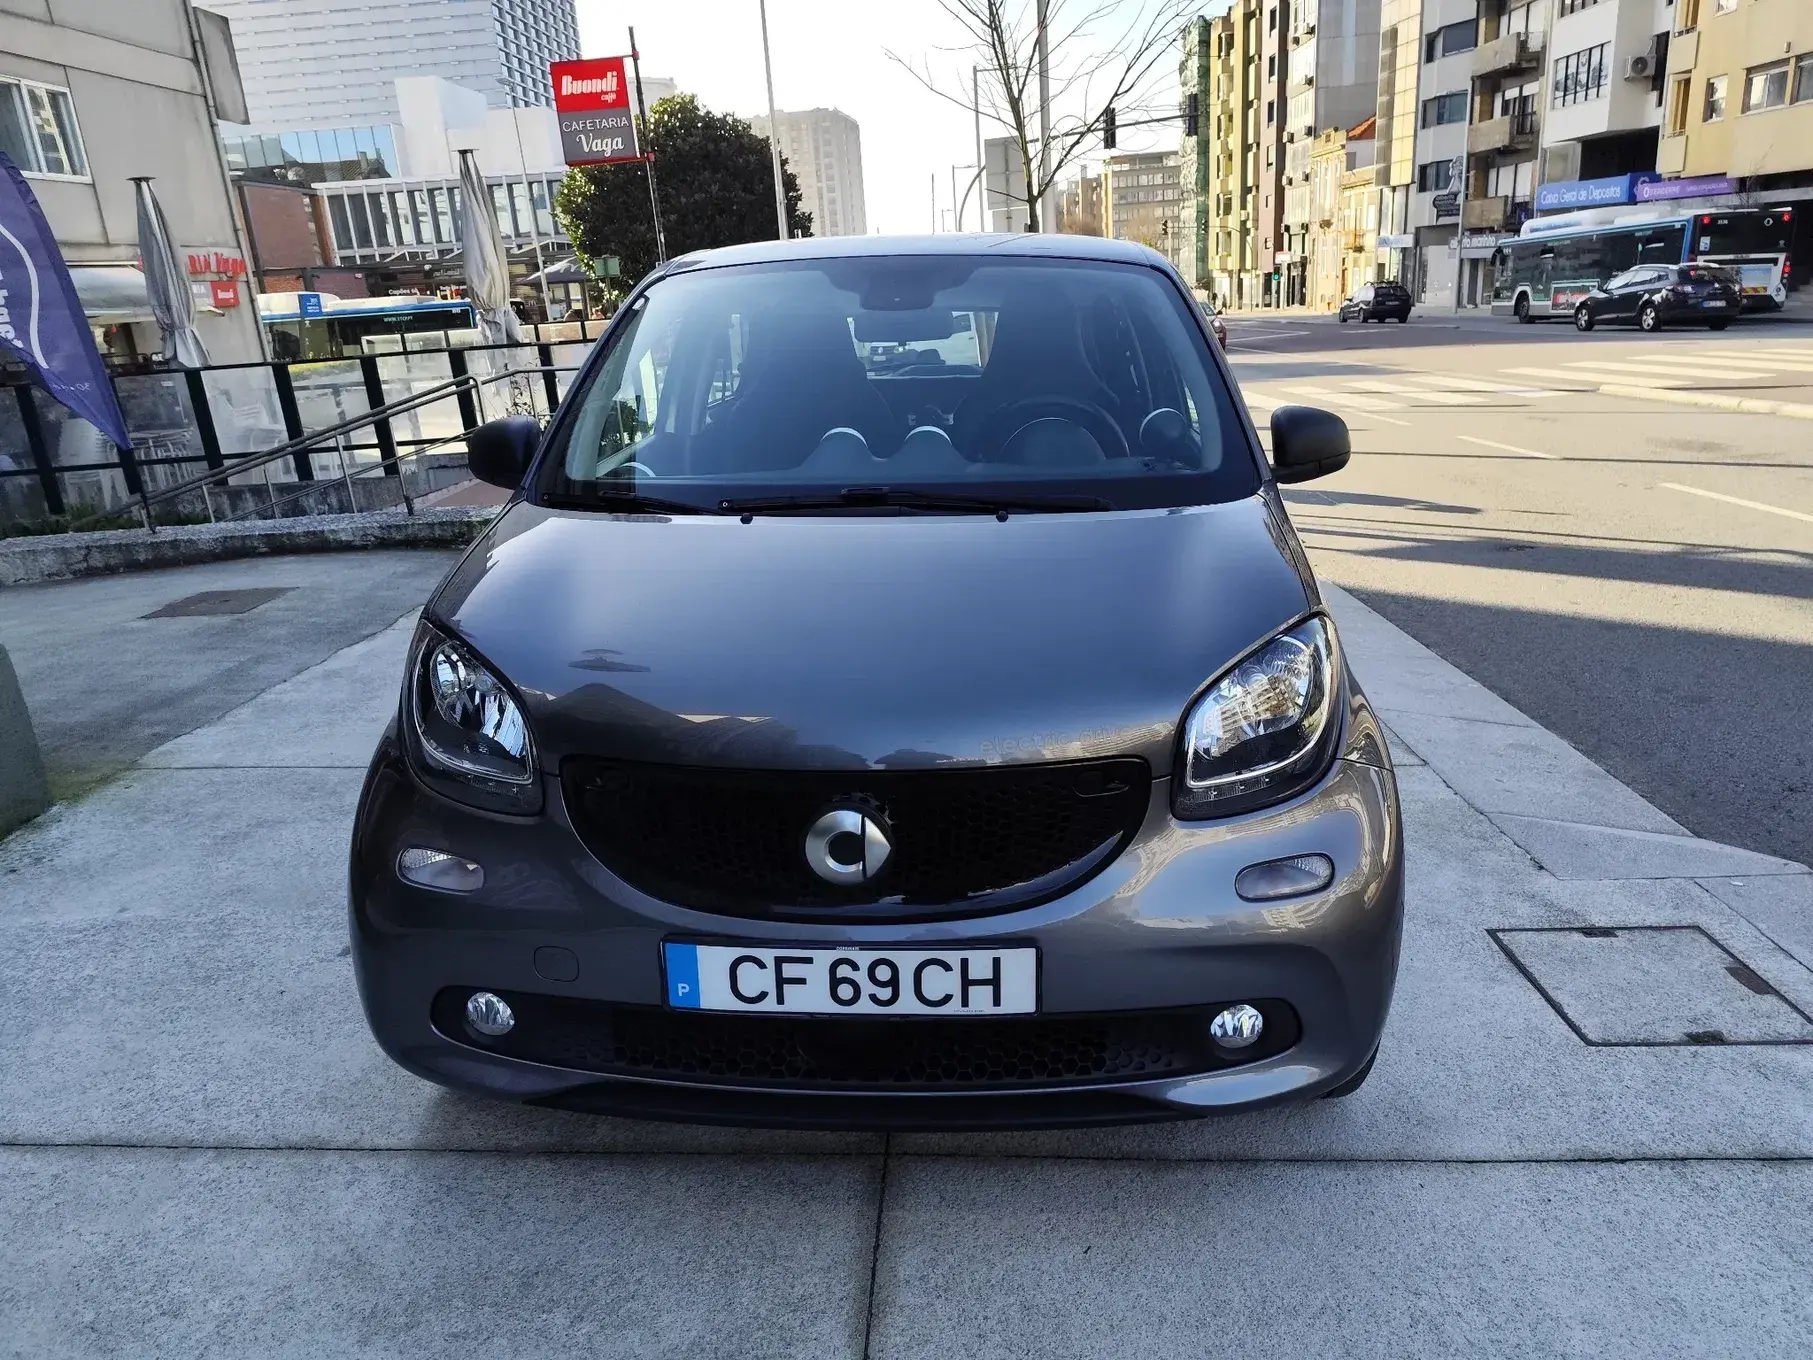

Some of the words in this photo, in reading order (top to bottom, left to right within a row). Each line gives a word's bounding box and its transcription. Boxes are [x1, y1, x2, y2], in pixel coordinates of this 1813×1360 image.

[561, 71, 618, 96] Buondi
[562, 116, 630, 133] CAFETARIA
[576, 132, 625, 158] Vaga
[1560, 188, 1577, 202] Geral
[1578, 188, 1588, 201] de
[979, 729, 1072, 756] electric
[1078, 724, 1133, 745] drive
[677, 982, 690, 997] P
[729, 954, 814, 1005] CF
[829, 957, 900, 1008] 69
[913, 956, 1001, 1008] CH
